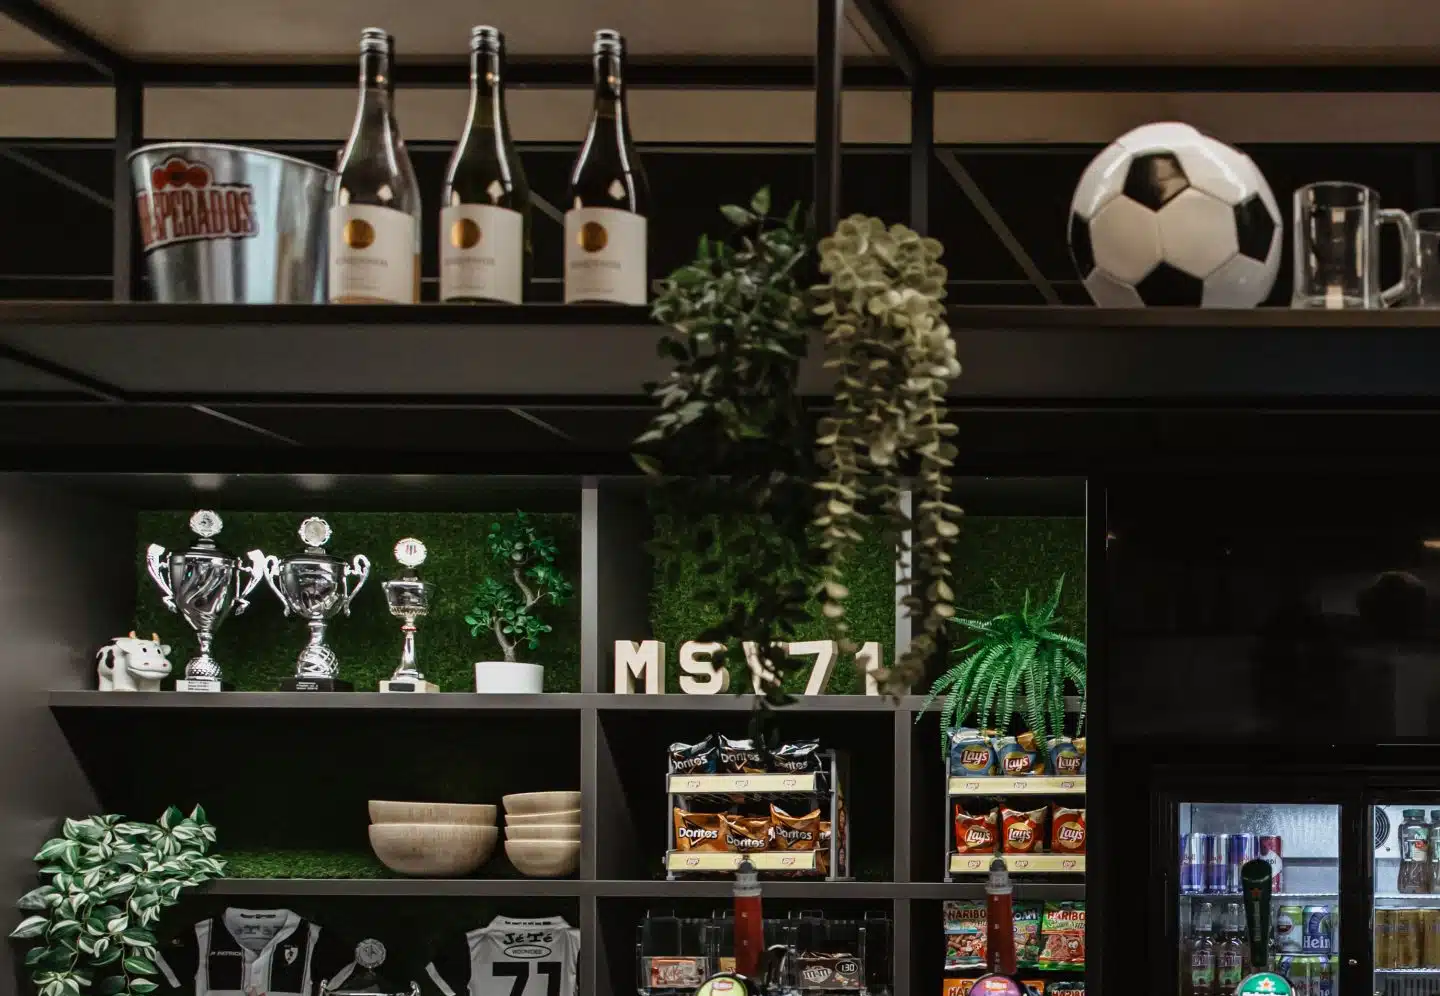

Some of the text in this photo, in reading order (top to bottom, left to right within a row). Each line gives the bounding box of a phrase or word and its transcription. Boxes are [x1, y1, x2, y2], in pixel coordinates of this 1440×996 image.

[678, 827, 719, 839] Doritos
[775, 826, 813, 840] Doritos
[726, 834, 765, 848] Doritos
[948, 909, 987, 919] HARIBO
[1303, 935, 1331, 949] Hein
